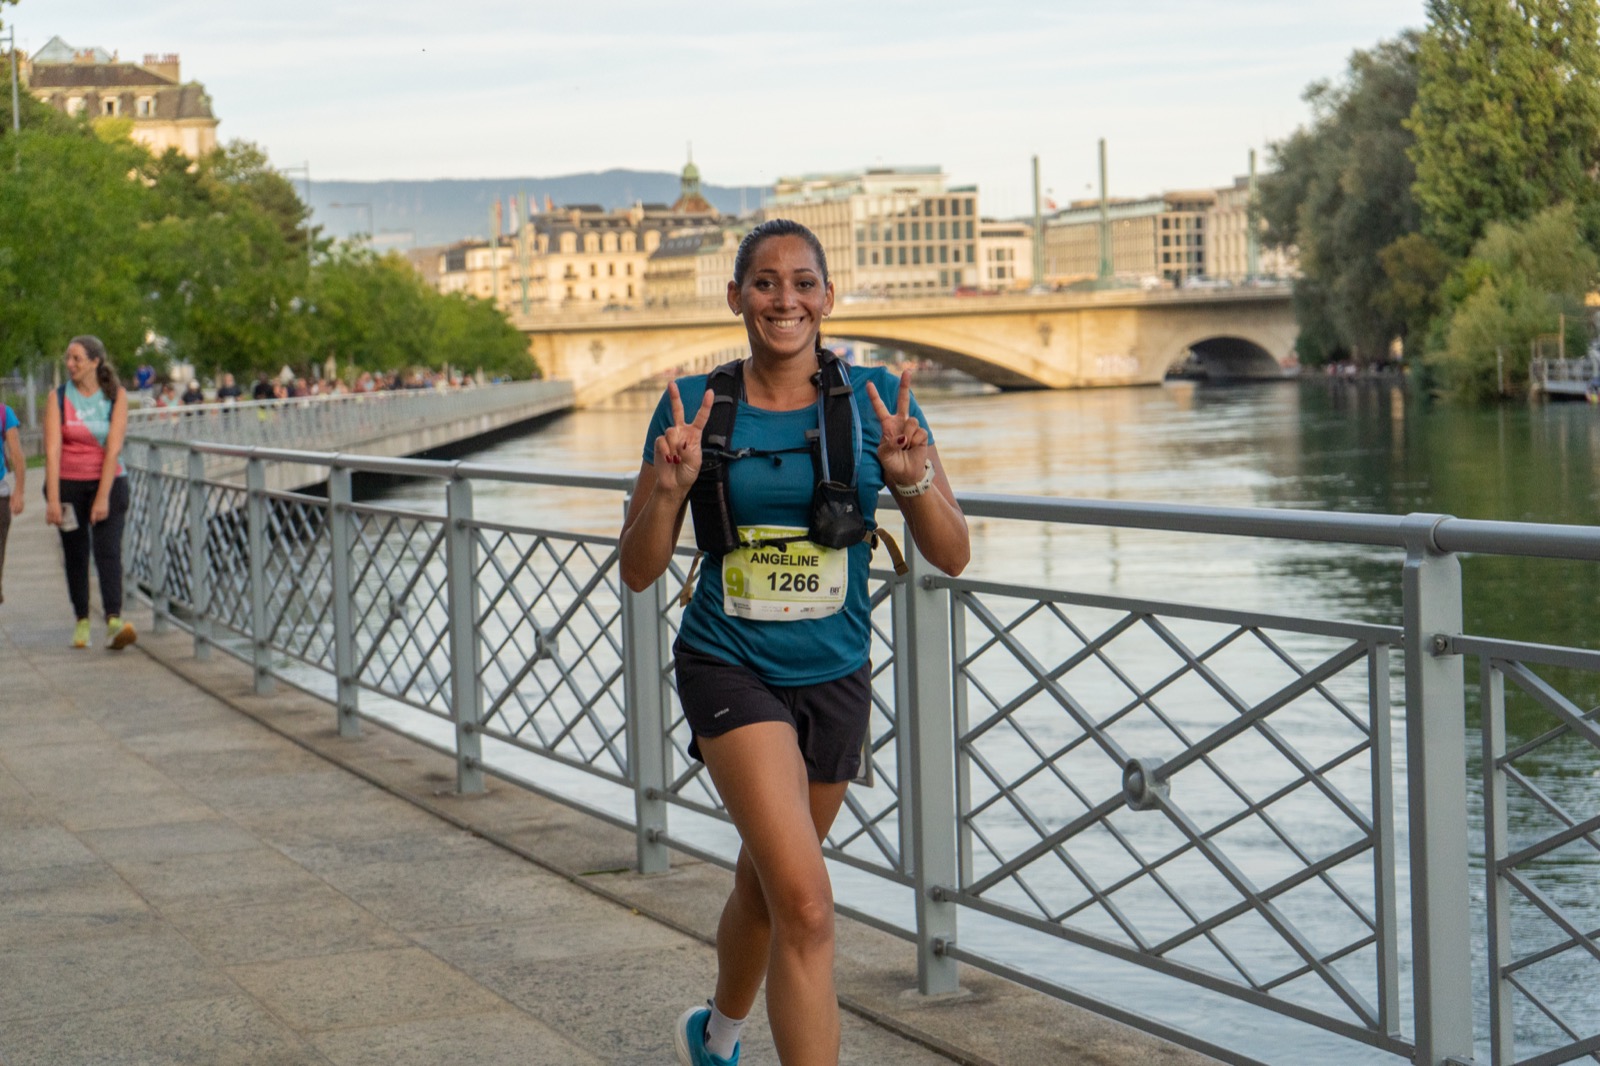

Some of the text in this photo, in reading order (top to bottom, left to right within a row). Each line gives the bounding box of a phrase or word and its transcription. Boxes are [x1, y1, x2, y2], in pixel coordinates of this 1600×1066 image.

[750, 552, 819, 567] ANGELINE
[725, 566, 744, 597] 9
[767, 571, 820, 593] 1266
